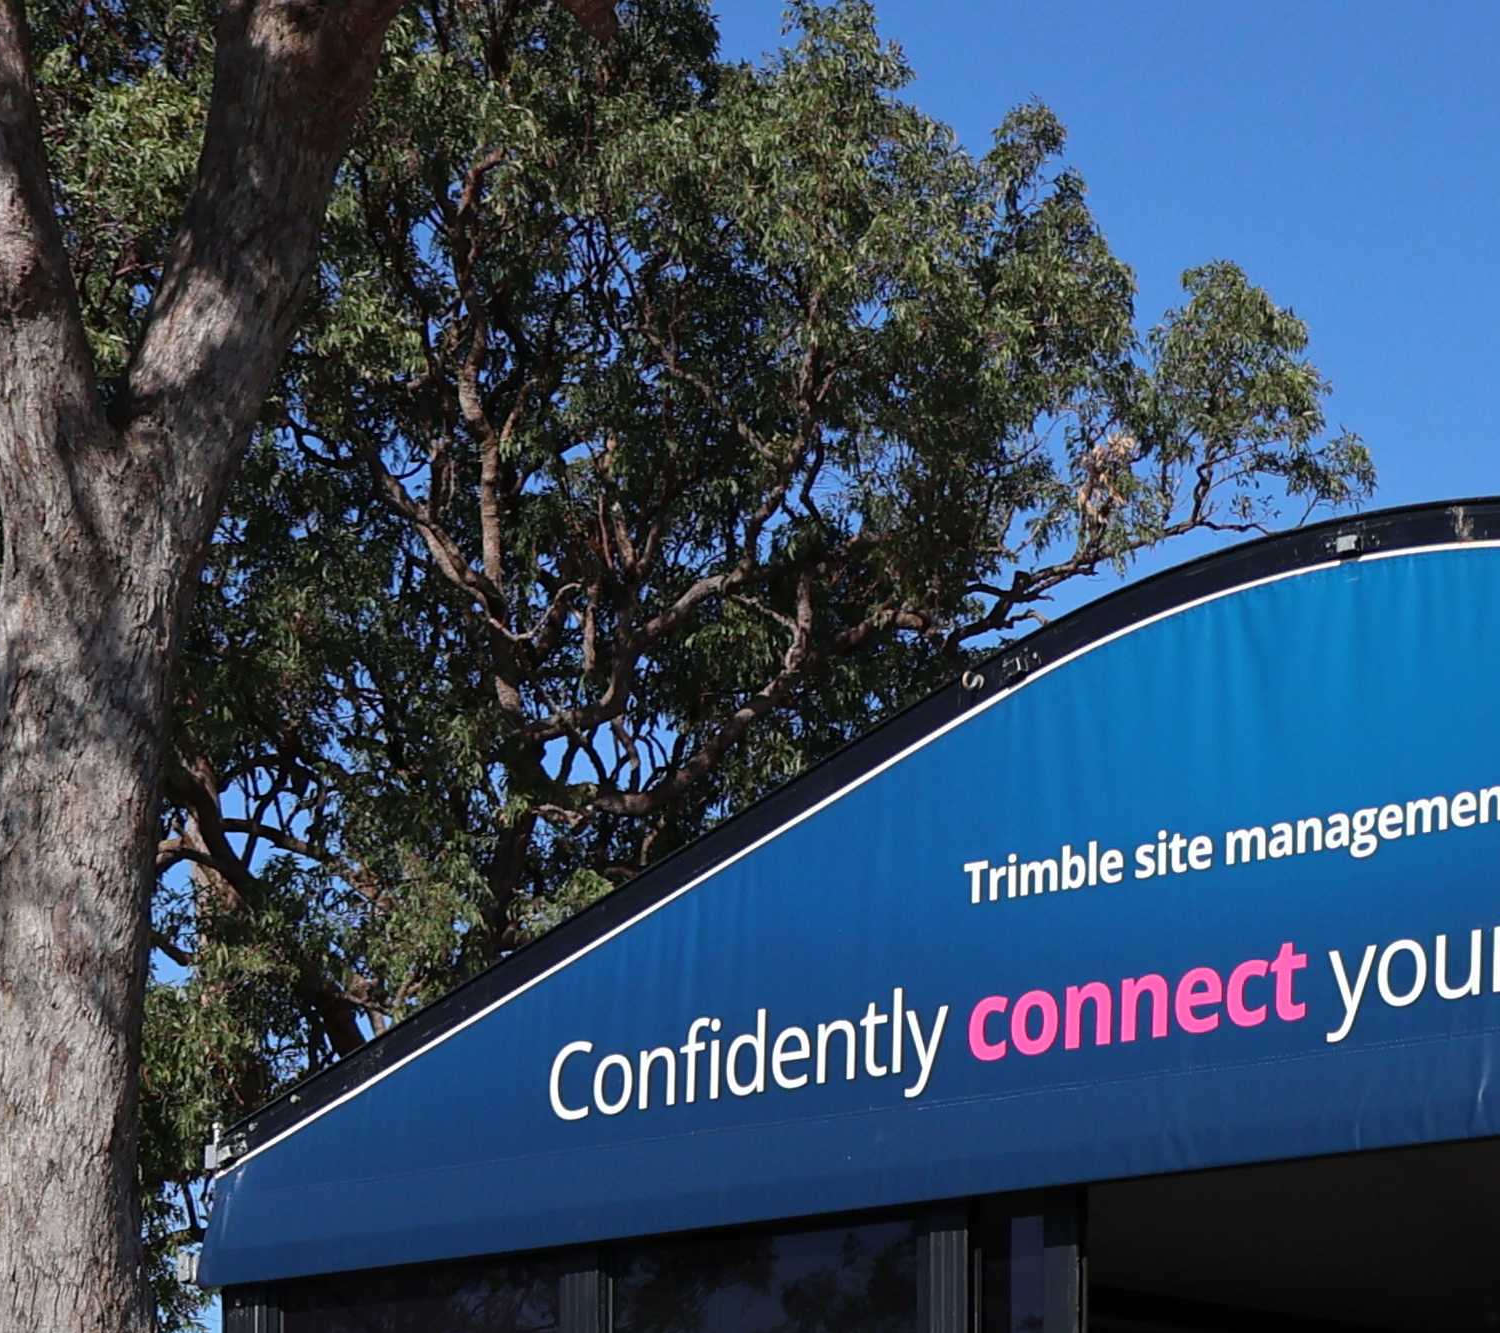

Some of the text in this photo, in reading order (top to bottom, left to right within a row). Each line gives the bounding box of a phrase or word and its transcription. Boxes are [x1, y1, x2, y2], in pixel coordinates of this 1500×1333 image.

[964, 840, 1123, 904] Trimble
[1134, 830, 1213, 881] site
[548, 987, 950, 1122] Confidently
[967, 942, 1308, 1062] connect
